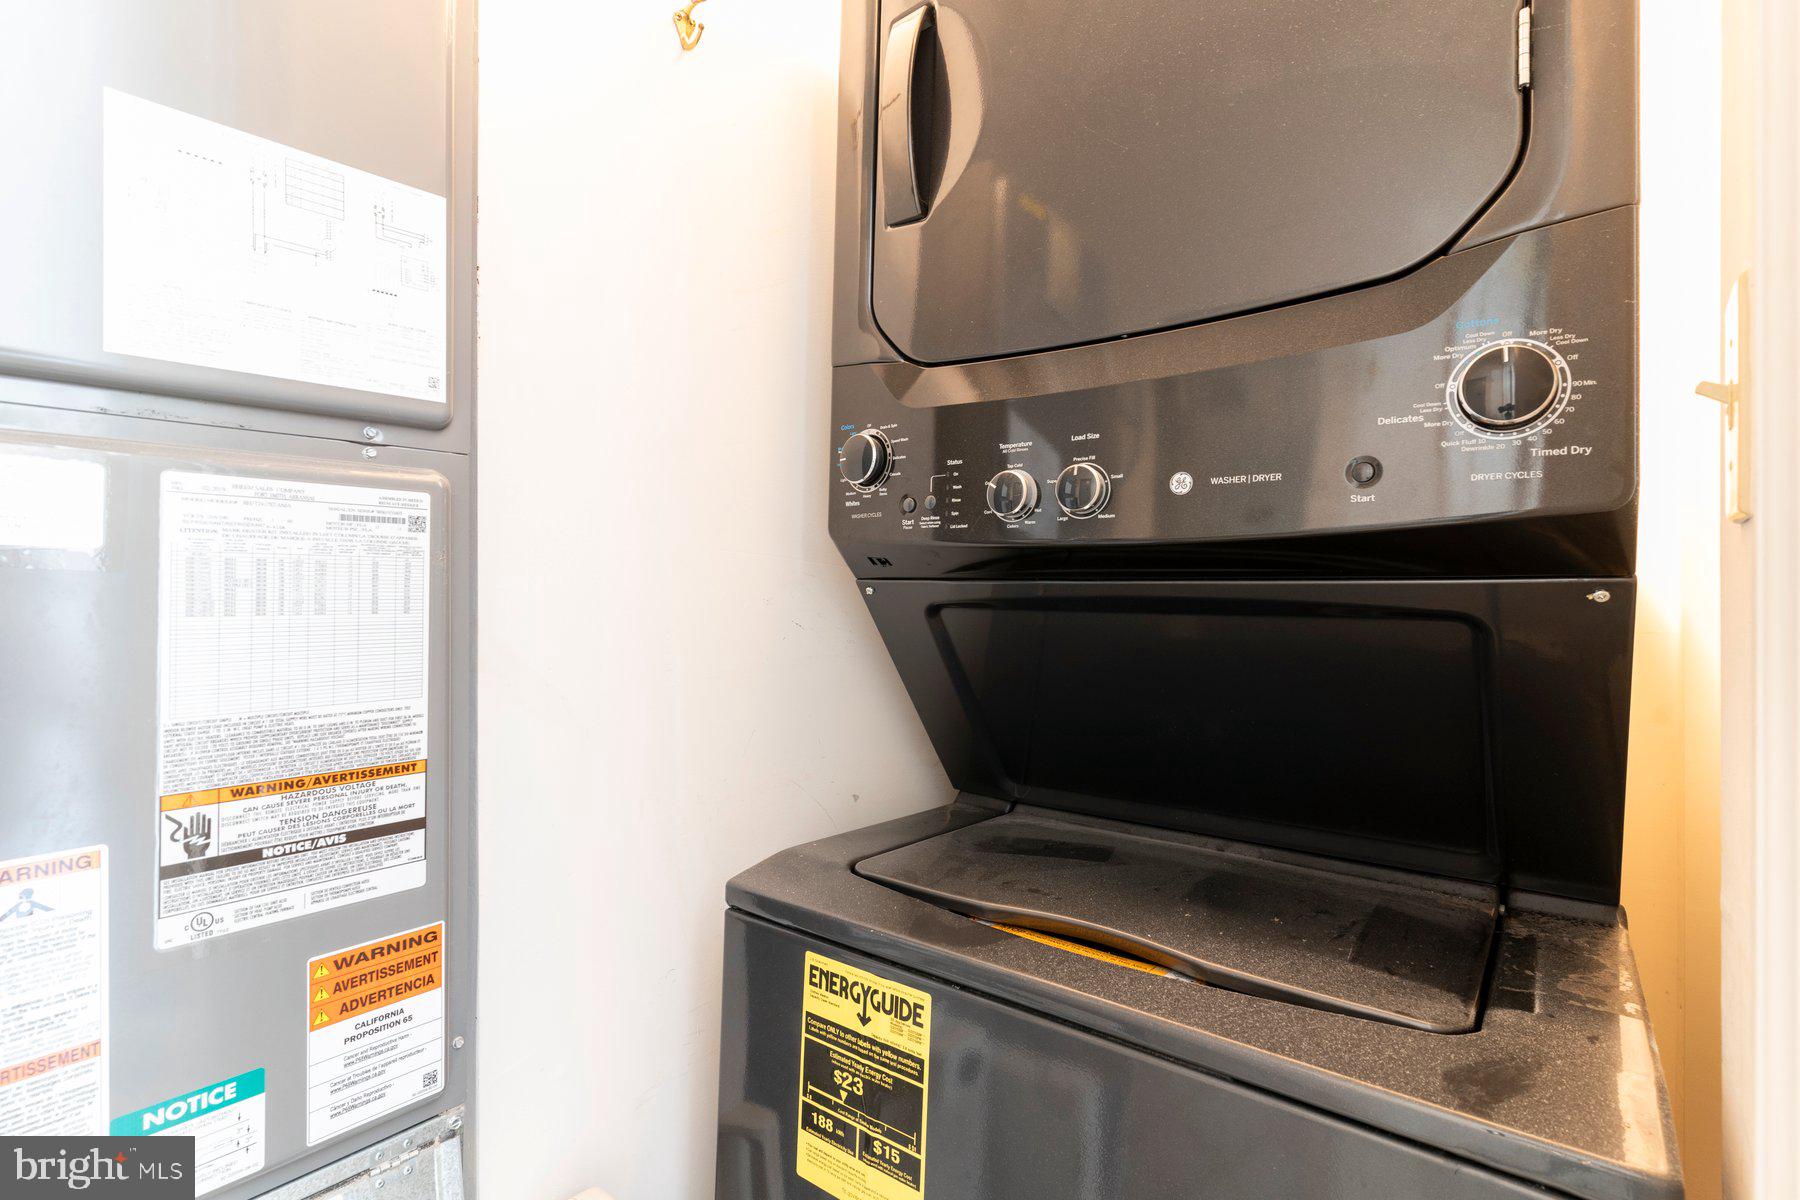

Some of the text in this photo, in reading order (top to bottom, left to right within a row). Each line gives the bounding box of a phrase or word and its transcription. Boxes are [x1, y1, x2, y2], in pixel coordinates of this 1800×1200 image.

[1444, 344, 1476, 352] Optimum
[1452, 352, 1464, 360] Dry
[1377, 414, 1424, 426] Delicates
[1441, 420, 1454, 428] Dry
[999, 441, 1033, 450] Temperature
[1071, 434, 1086, 442] Load
[1441, 440, 1460, 448] Quick
[1531, 445, 1593, 457] Timed Dry
[1210, 473, 1283, 485] WASHER DRYER
[1470, 471, 1543, 481] DRYER CYCLES
[1350, 494, 1376, 503] Start
[230, 763, 417, 798] WARNING/AVERTISSEMENT
[280, 781, 376, 801] HAZARDOUS VOLTAGE
[243, 805, 259, 813] CAN
[261, 802, 284, 811] CAUSE
[286, 797, 312, 806] SEVERE
[313, 791, 348, 804] PERSONAL
[350, 787, 374, 796] INJURY
[385, 782, 408, 791] DEATH.
[237, 831, 256, 839] PEUT
[258, 826, 286, 835] CAUSER
[287, 823, 301, 832] DES
[302, 817, 331, 828] LESIONS
[332, 809, 376, 822] CORPORELLES
[398, 802, 416, 810] MORT
[280, 811, 319, 826] TENSION
[322, 803, 377, 819] DANGEREUSE
[262, 833, 347, 858] NOTICE/AVIS
[0, 855, 91, 884] ARNING
[190, 930, 214, 940] LISTED
[332, 931, 438, 971] WARNING
[333, 951, 439, 995] AVERTISSEMENT
[338, 973, 435, 1016] ADVERTENCIA
[808, 963, 925, 1029] ENERGYGUIDE
[343, 1014, 413, 1046] PROPOSITION 65
[354, 1007, 405, 1030] CALIFORNIA
[343, 1054, 360, 1062] Cancer
[369, 1037, 397, 1052] Reproductive
[398, 1033, 410, 1042] Harm
[807, 1016, 921, 1071] Compare ONLY to other labels with yellow numbers.
[329, 1078, 347, 1088] Cancer
[352, 1068, 371, 1079] Troubles
[398, 1047, 425, 1062] reproducteur
[829, 1050, 893, 1084] Estimated Yearly Energy Cost
[363, 1083, 393, 1098] Reproductivo
[833, 1069, 864, 1096] $23
[142, 1081, 237, 1131] NOTICE
[811, 1112, 834, 1133] 188
[872, 1140, 901, 1165] $15
[890, 1165, 904, 1178] Energy
[903, 1172, 913, 1181] Cost
